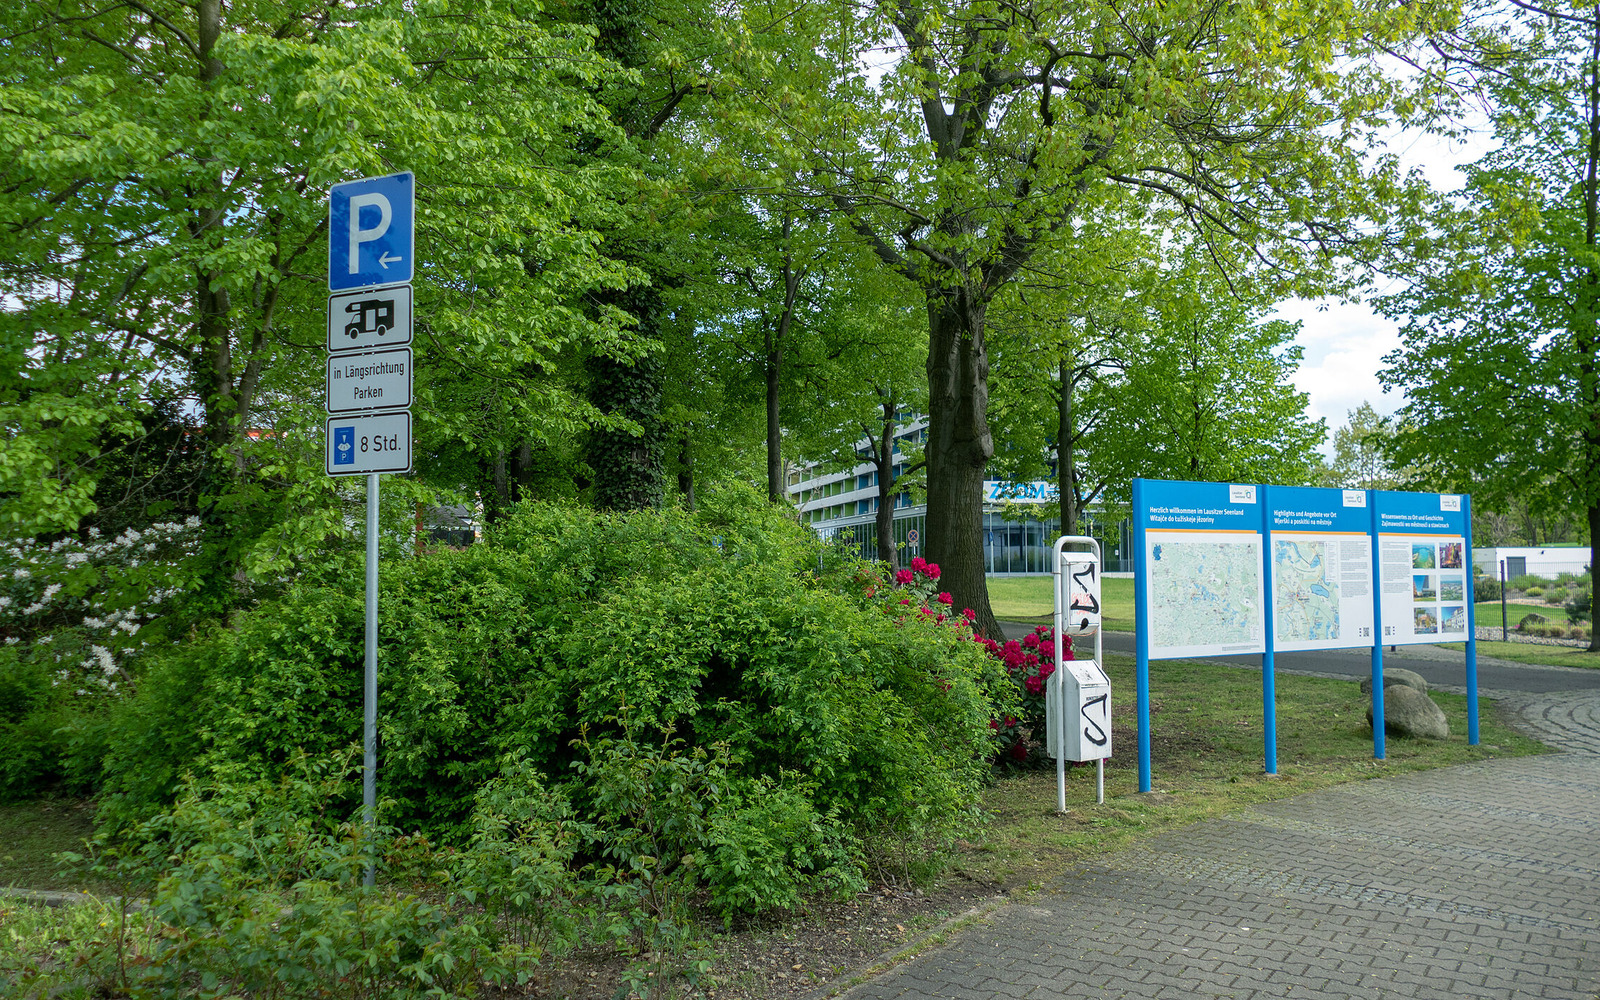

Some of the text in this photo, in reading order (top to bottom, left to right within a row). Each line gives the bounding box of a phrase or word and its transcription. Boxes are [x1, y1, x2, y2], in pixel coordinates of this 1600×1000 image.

[349, 192, 392, 274] P
[334, 362, 404, 380] in Längsrichtung
[354, 386, 383, 399] Parken
[360, 434, 401, 452] 8 Std.
[341, 453, 347, 461] P
[1274, 510, 1295, 518] Highlights
